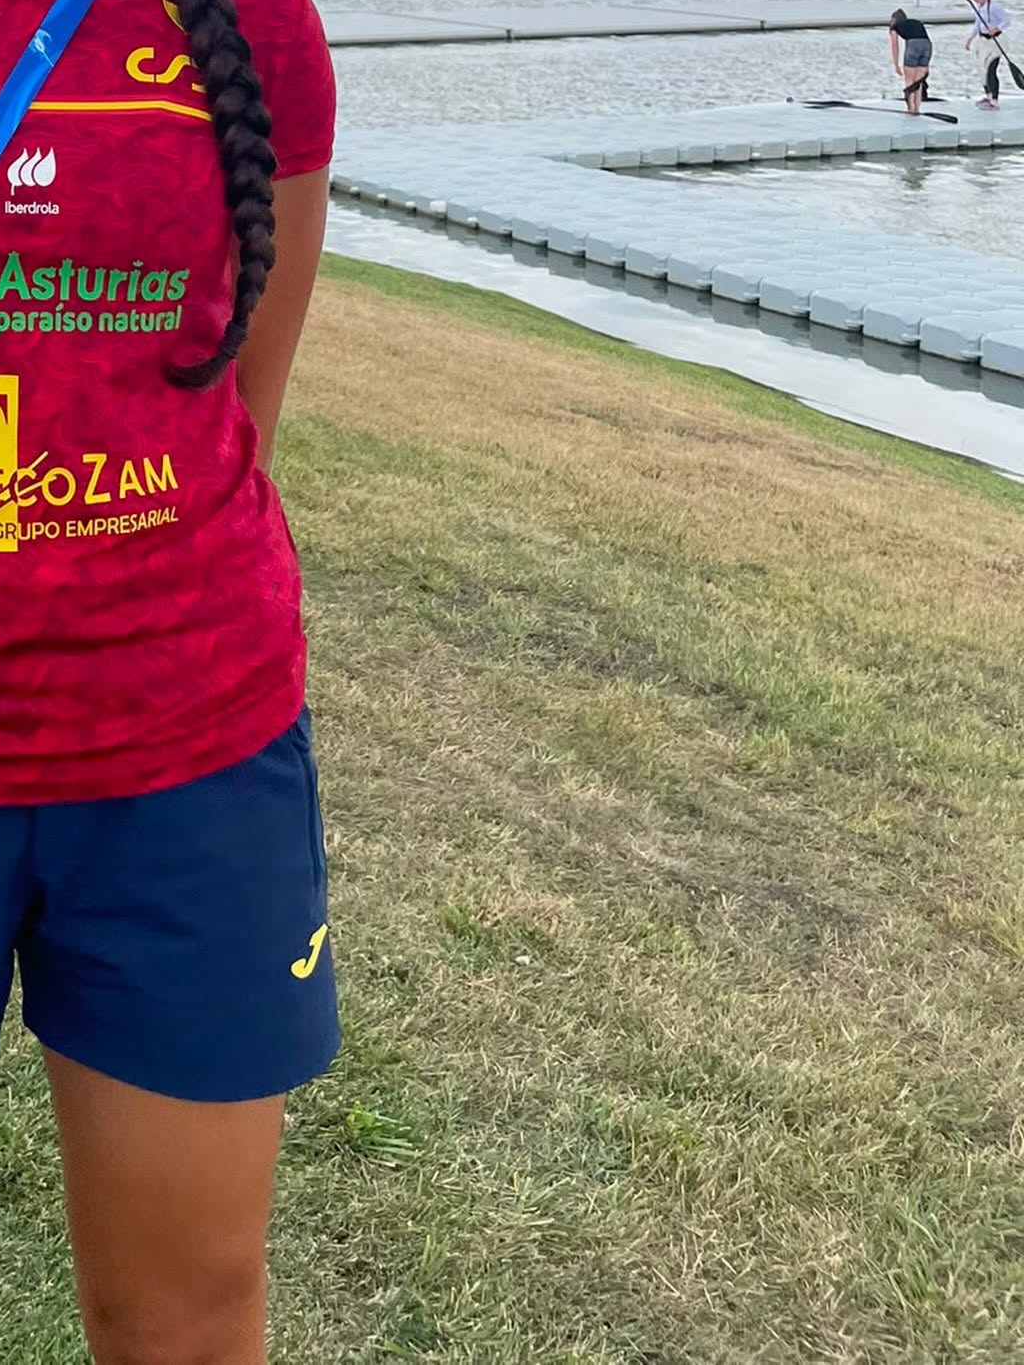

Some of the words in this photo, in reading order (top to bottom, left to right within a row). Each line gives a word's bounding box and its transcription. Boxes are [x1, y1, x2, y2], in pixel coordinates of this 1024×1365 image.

[4, 201, 60, 215] Iberdrola
[98, 306, 183, 332] natural
[65, 506, 179, 538] EMPRESARIAL
